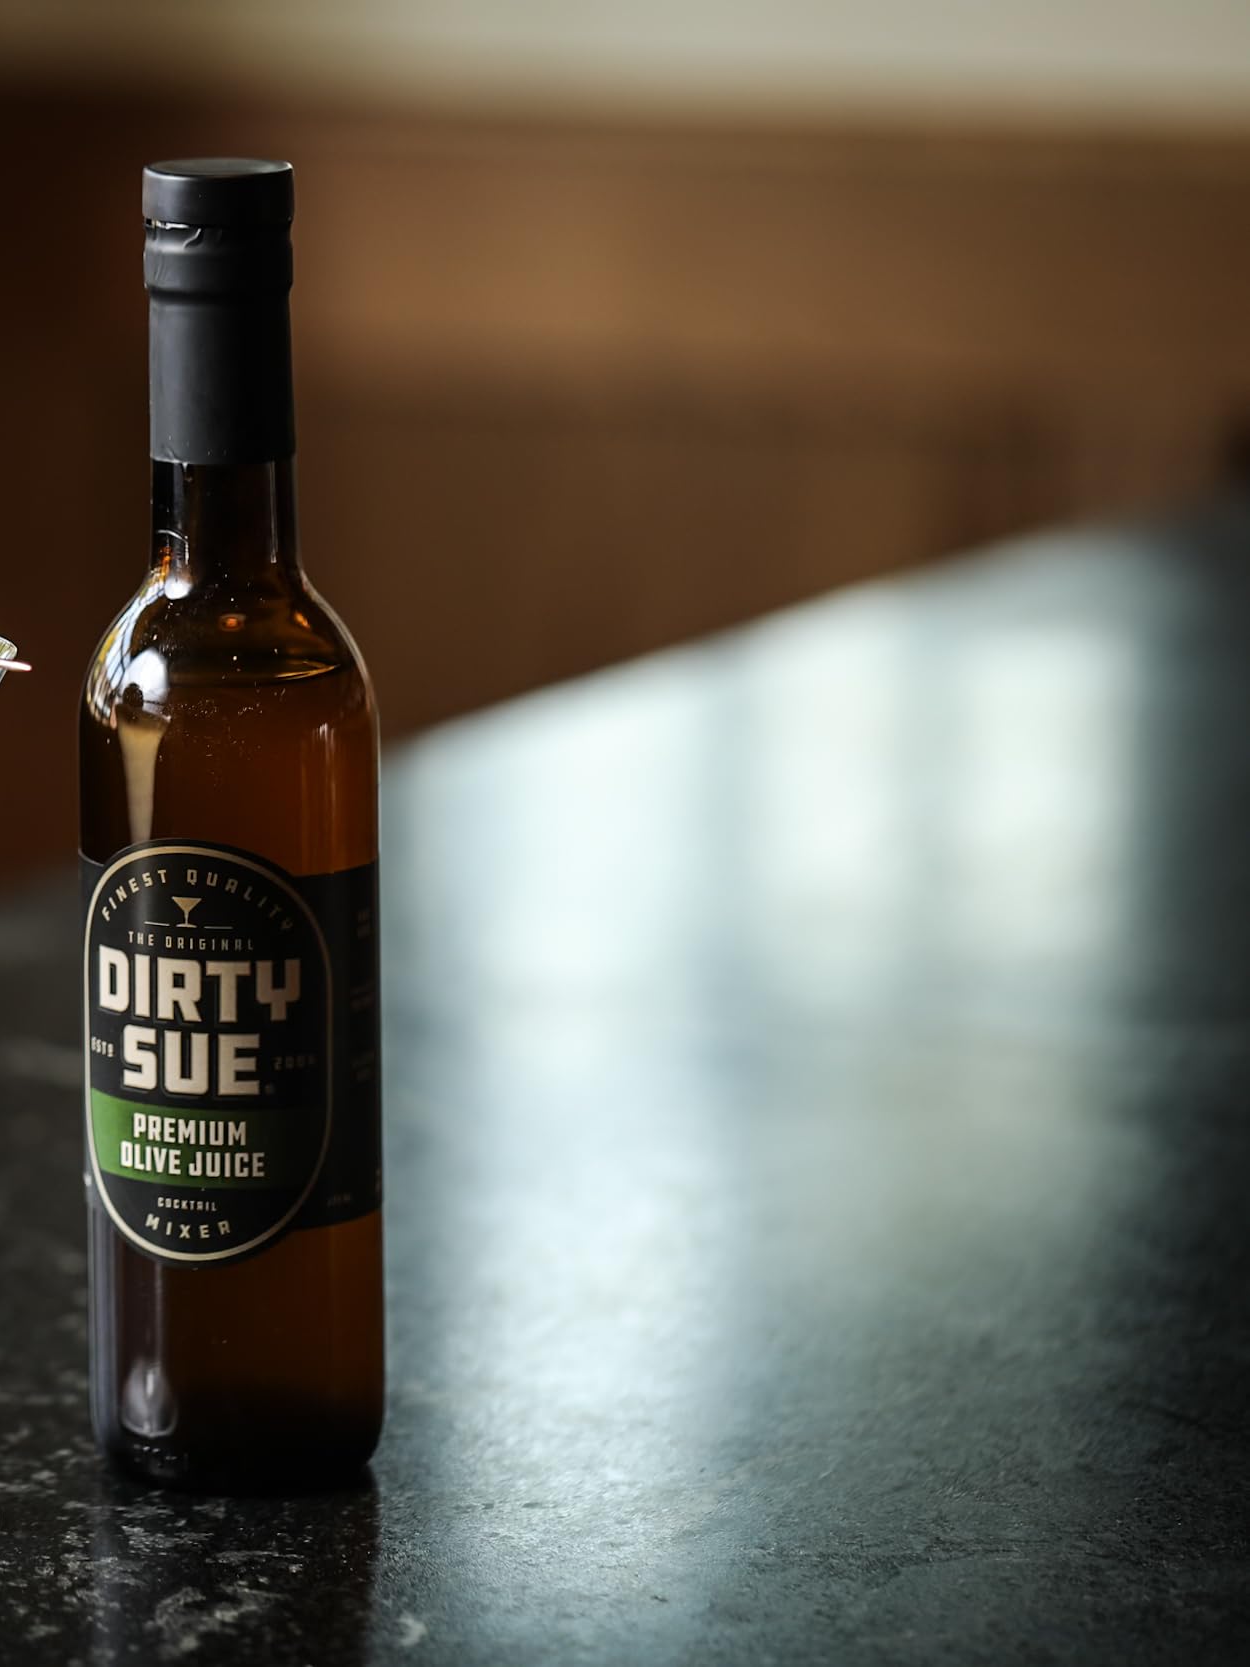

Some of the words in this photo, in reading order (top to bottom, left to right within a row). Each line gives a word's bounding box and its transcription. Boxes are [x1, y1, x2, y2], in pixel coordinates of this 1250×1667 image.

[101, 868, 168, 922] FINEST
[186, 868, 295, 931] QUALITY
[128, 930, 155, 947] THE
[165, 935, 254, 951] ORIGINAL
[99, 944, 301, 1024] DIRTY
[122, 1023, 261, 1096] SUE
[132, 1111, 247, 1147] PREMIUM
[119, 1140, 182, 1176] OLIVE
[188, 1150, 266, 1178] JUICE
[157, 1196, 218, 1212] COCKTAIL
[145, 1213, 231, 1240] MIXER
